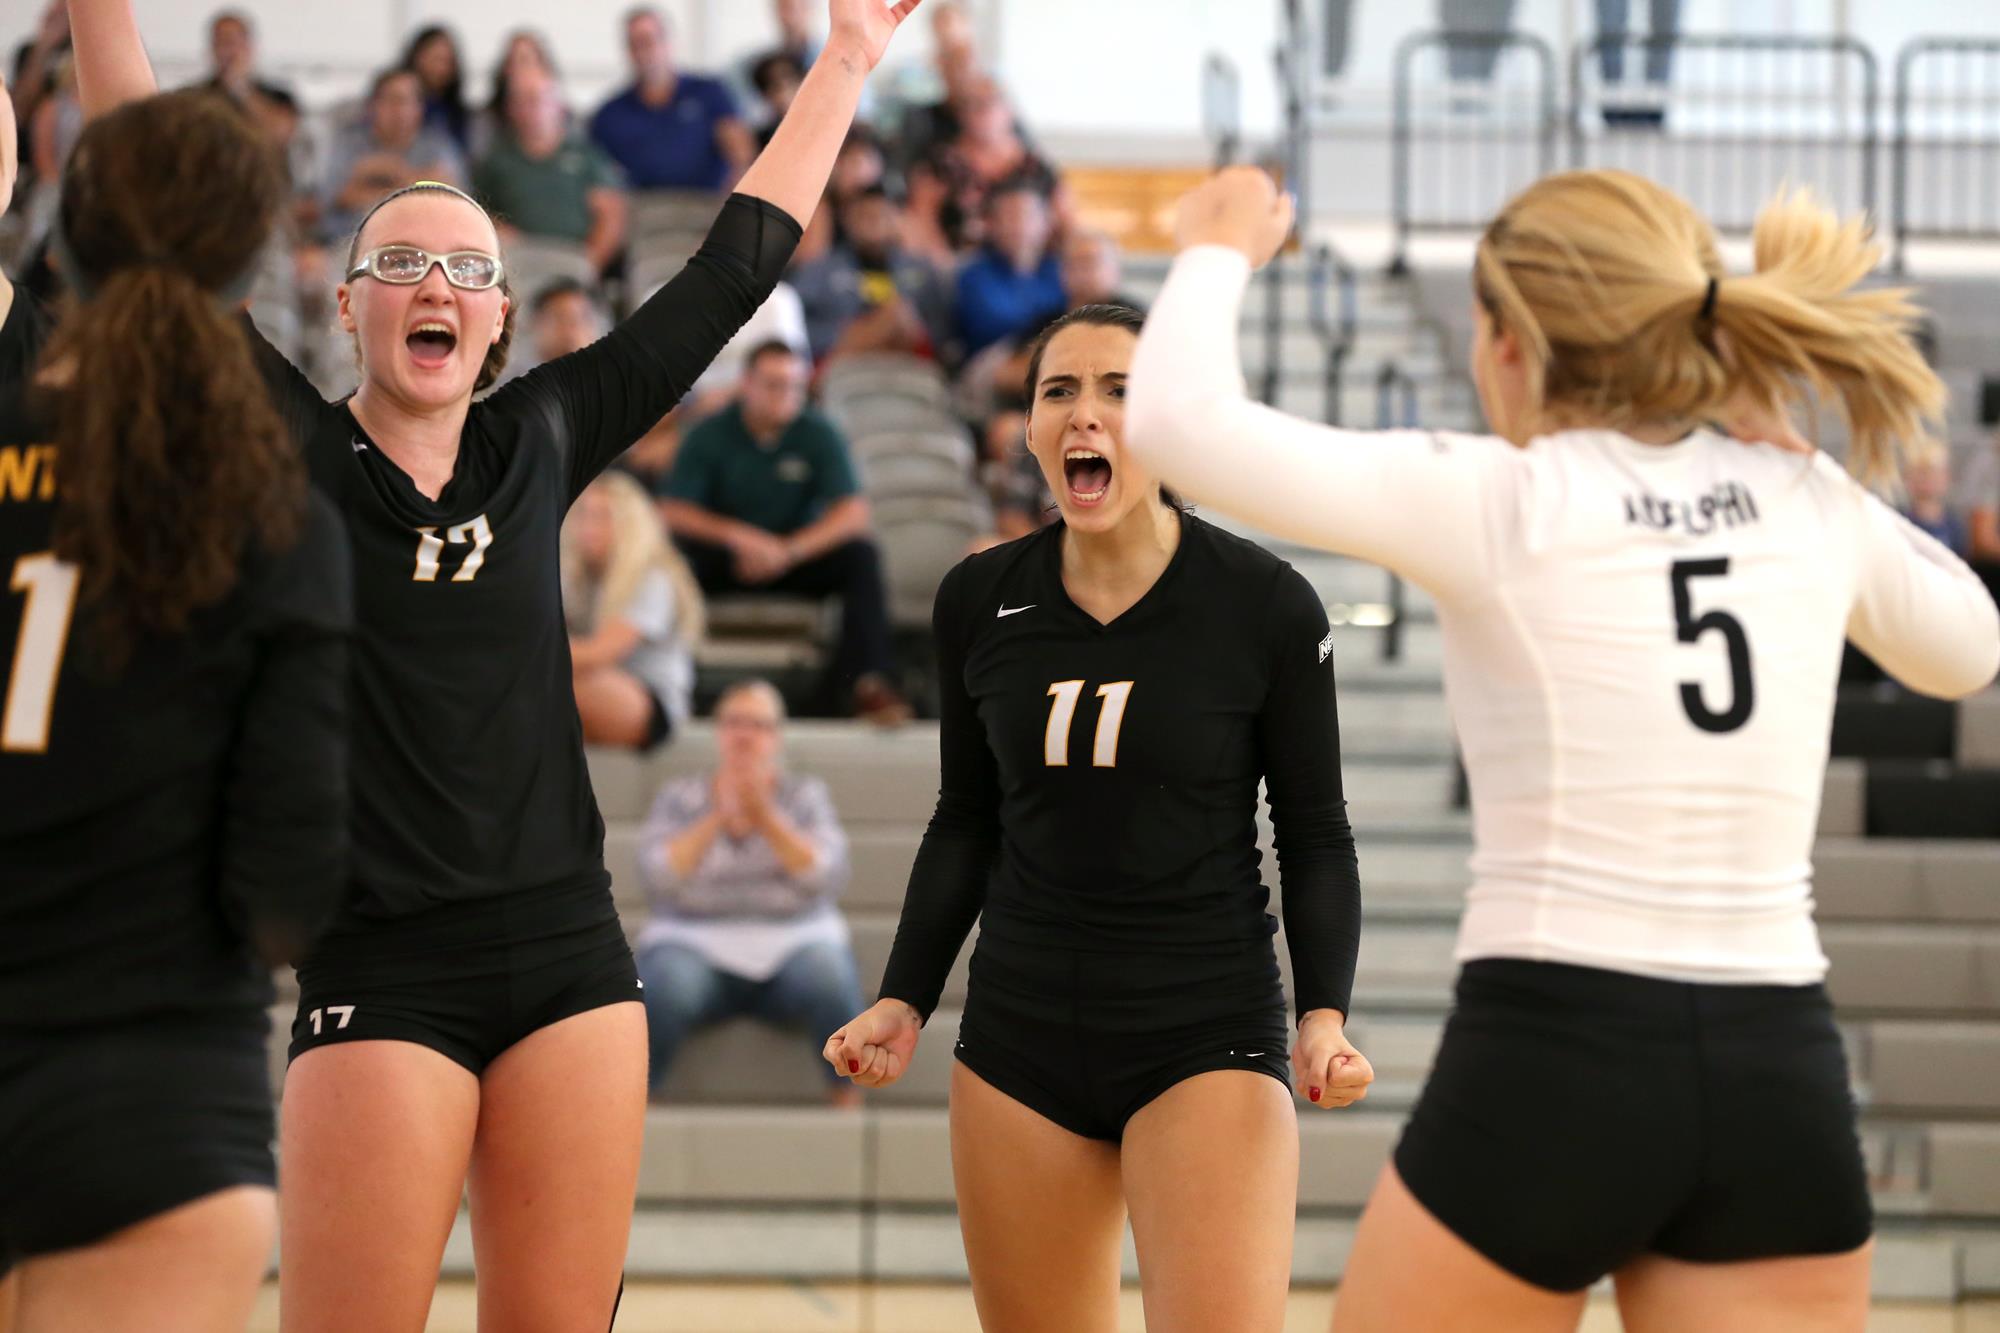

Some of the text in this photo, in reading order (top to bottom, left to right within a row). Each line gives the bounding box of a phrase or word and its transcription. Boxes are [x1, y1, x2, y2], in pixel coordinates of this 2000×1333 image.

[412, 512, 494, 581] 17
[1669, 556, 1756, 734] 5
[1045, 679, 1135, 768] 11
[309, 1005, 356, 1035] 17
